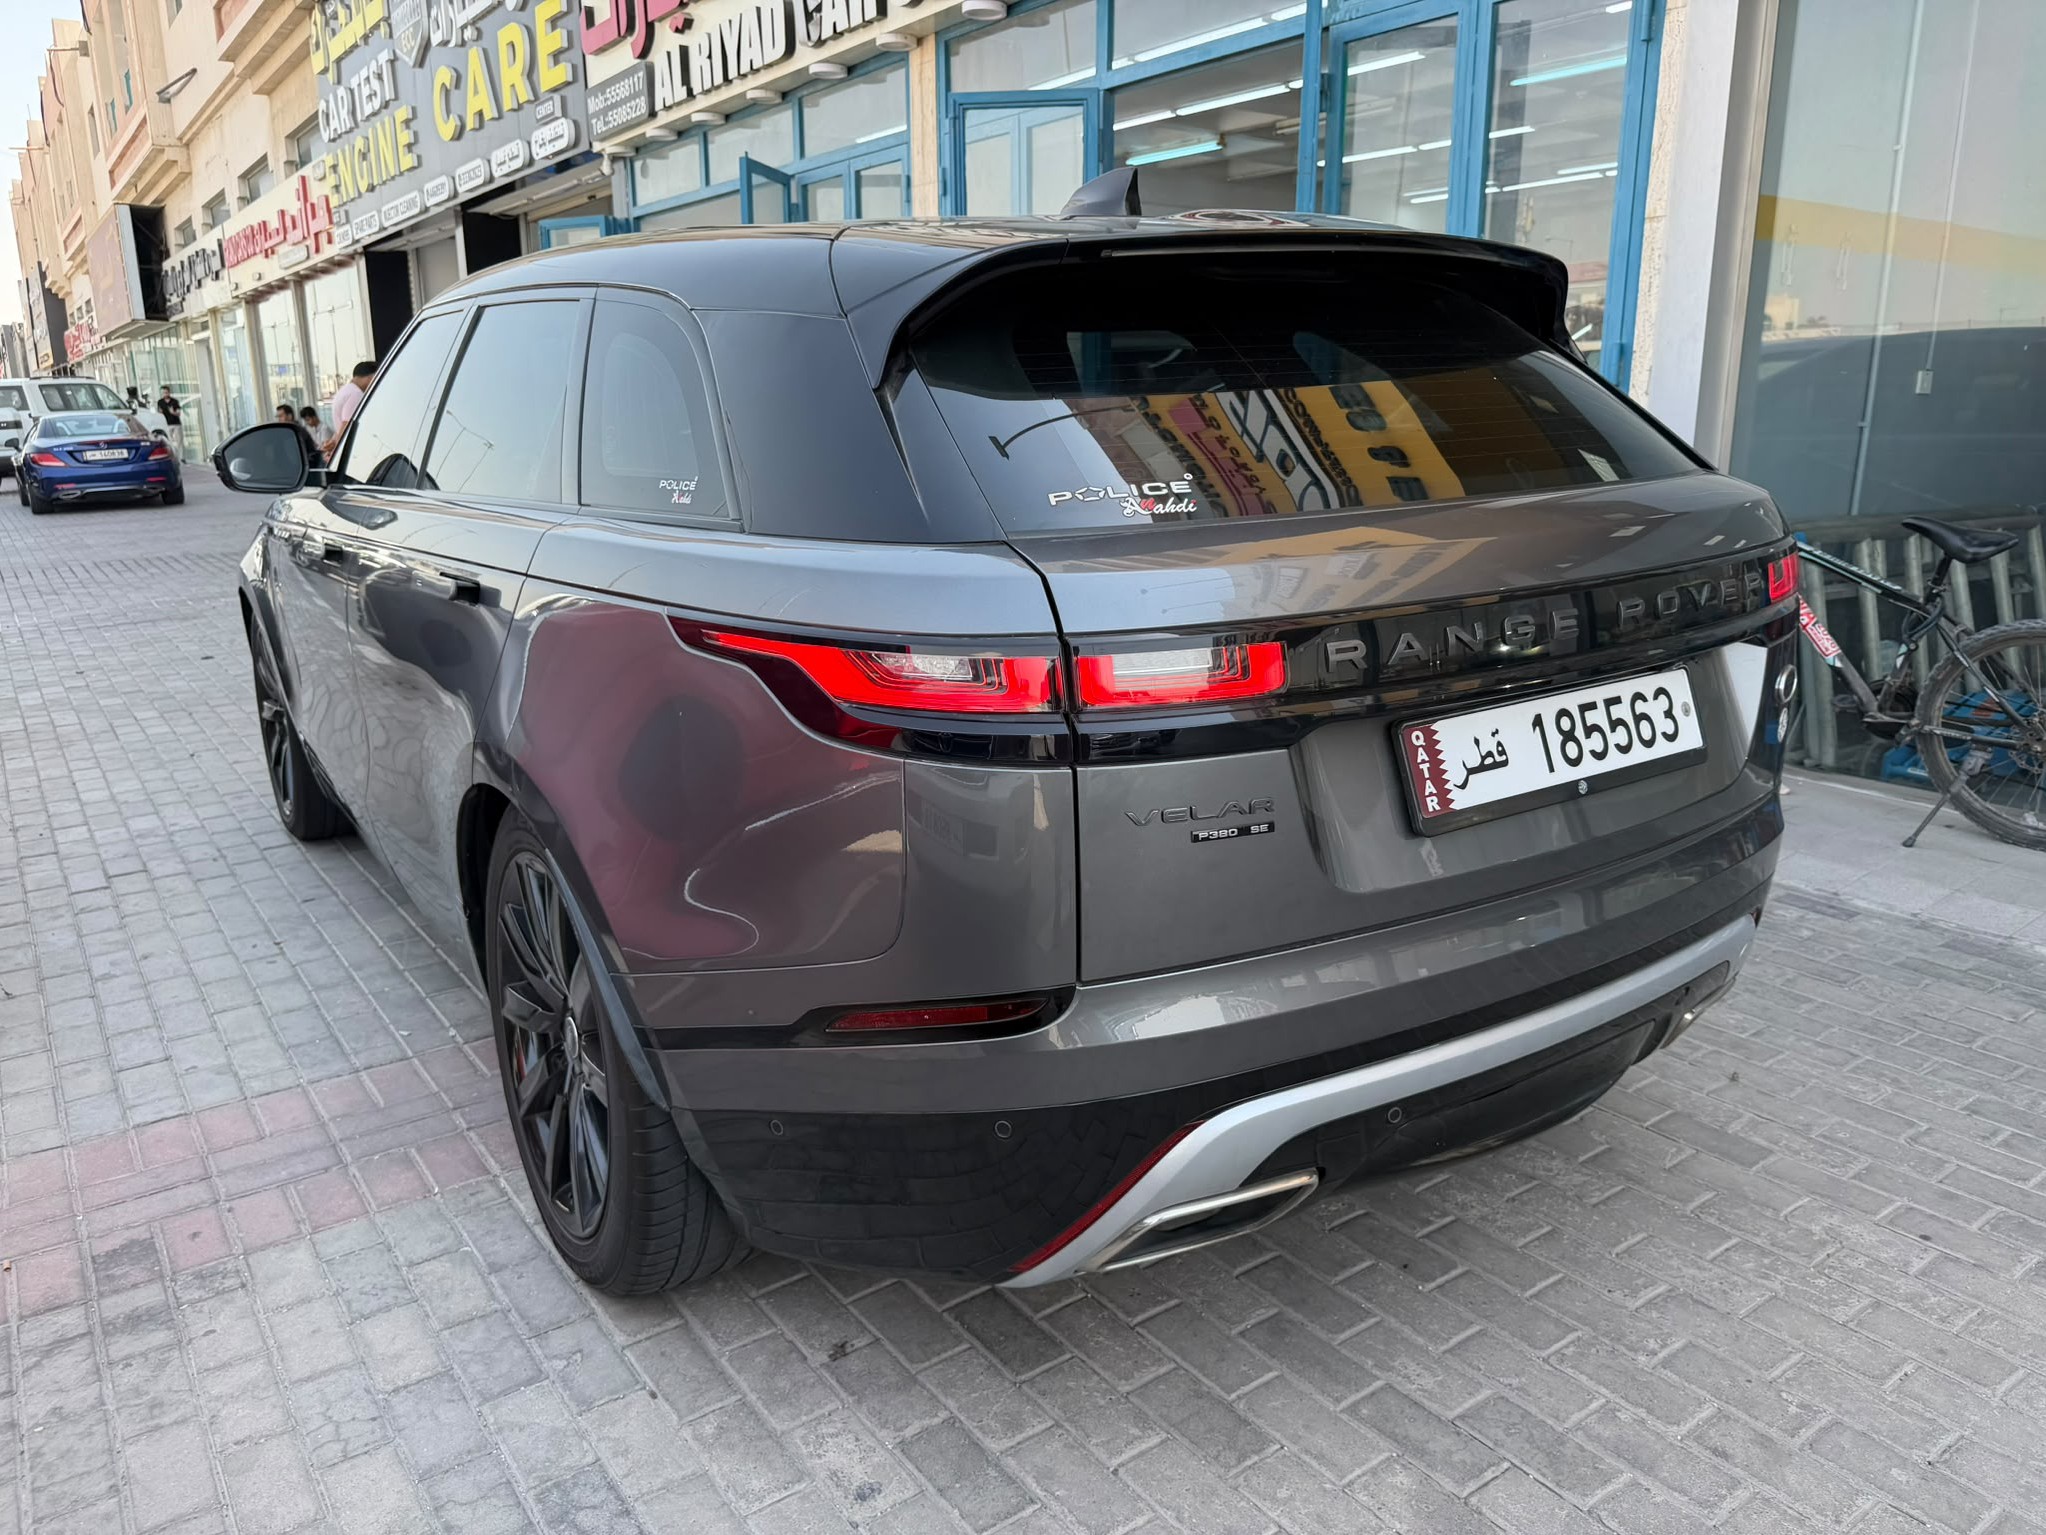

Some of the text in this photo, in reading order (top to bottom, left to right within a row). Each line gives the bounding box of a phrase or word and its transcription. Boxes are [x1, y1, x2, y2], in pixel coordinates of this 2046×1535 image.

[318, 49, 396, 143] CAR TEST
[655, 43, 690, 112] AL
[694, 0, 788, 96] RIYAD
[325, 104, 419, 209] ENGINE
[433, 0, 573, 142] CARE
[659, 479, 697, 490] POLICE
[1048, 479, 1192, 506] POLICE
[1325, 573, 1762, 676] RANGE ROVER
[1411, 730, 1441, 813] QATAR
[1453, 728, 1509, 790] قطر
[1531, 686, 1680, 774] 185563
[1124, 797, 1276, 826] VELAR
[1198, 824, 1269, 841] P380 SE
